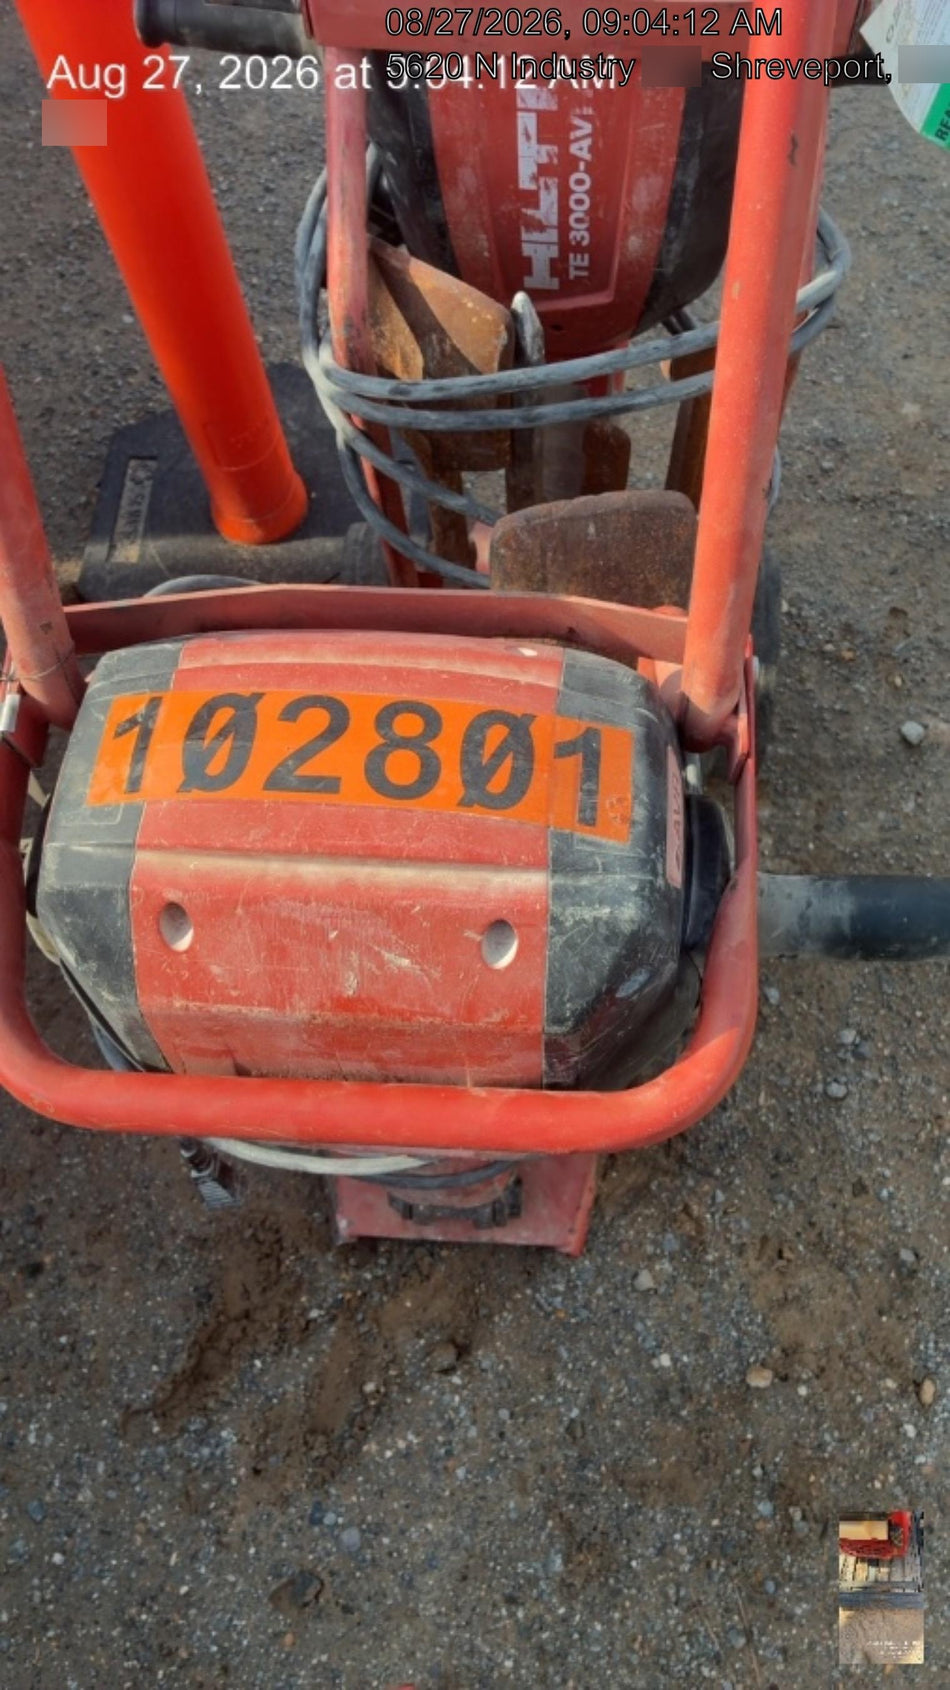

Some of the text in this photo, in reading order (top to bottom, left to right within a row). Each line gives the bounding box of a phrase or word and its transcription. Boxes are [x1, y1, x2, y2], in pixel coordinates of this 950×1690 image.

[516, 86, 560, 290] HILTI
[569, 102, 595, 280] TE 3000-AV
